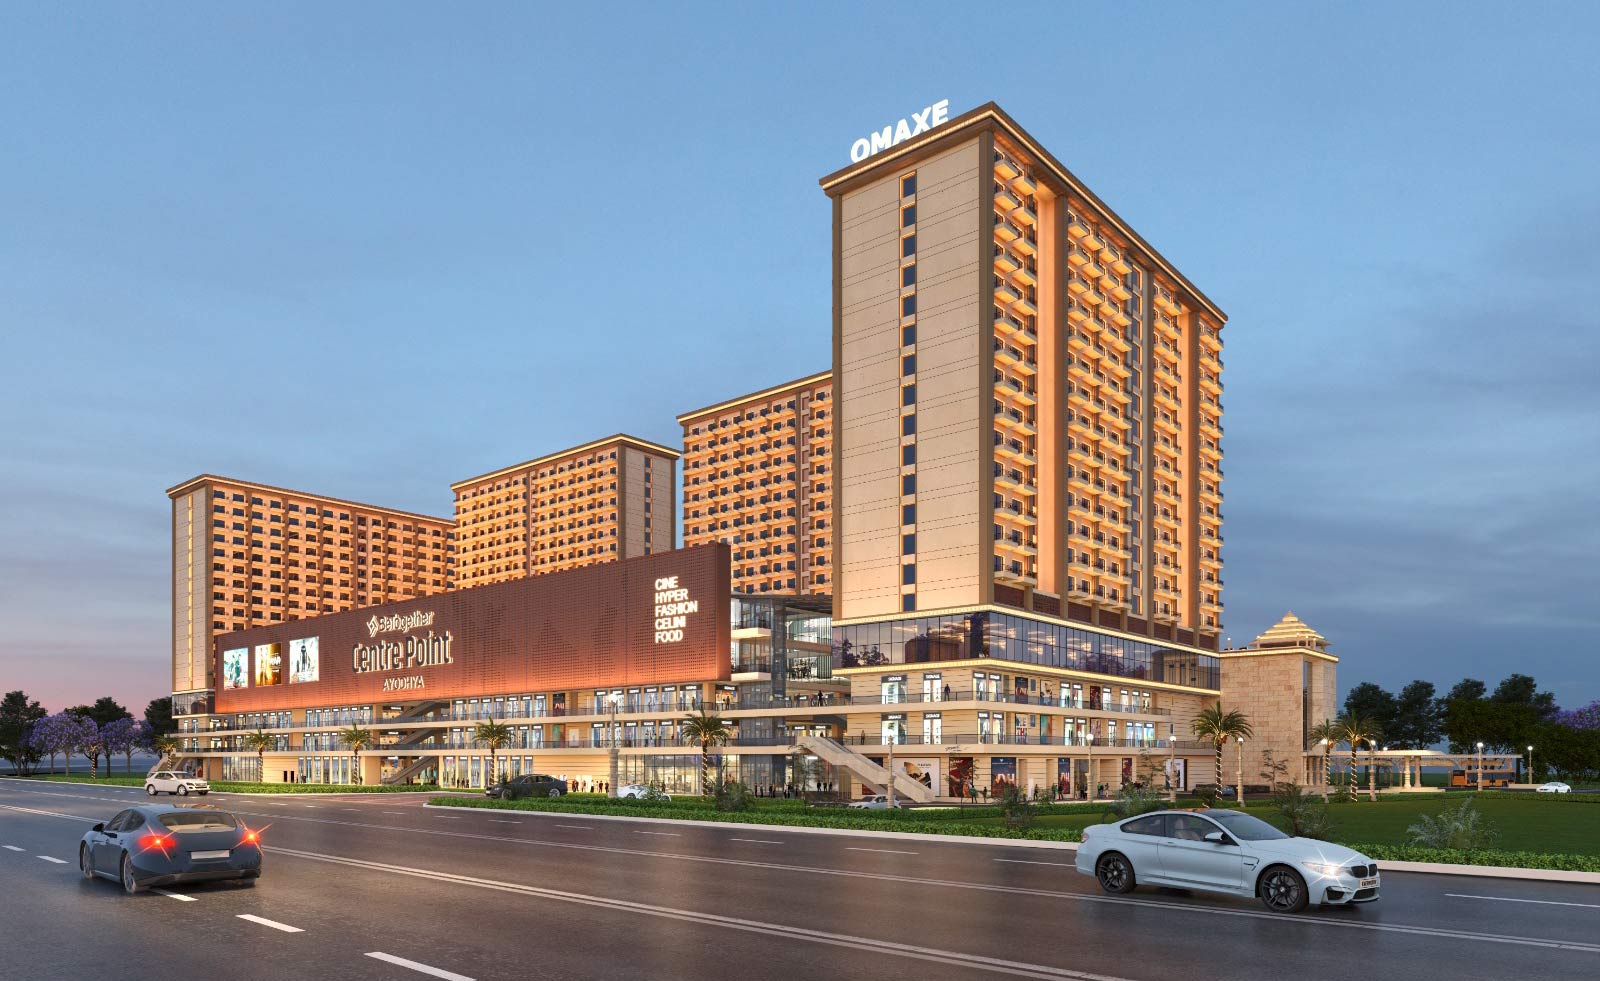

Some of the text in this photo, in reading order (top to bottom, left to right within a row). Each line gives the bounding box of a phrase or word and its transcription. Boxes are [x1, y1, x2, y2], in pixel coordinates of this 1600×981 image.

[850, 99, 949, 163] OMAXE
[655, 576, 679, 590] CINE
[655, 588, 689, 604] HYPER
[655, 600, 698, 617] FASHION
[655, 629, 684, 644] FOOD
[352, 631, 454, 673] Centre Point
[383, 676, 425, 691] AYODHYA
